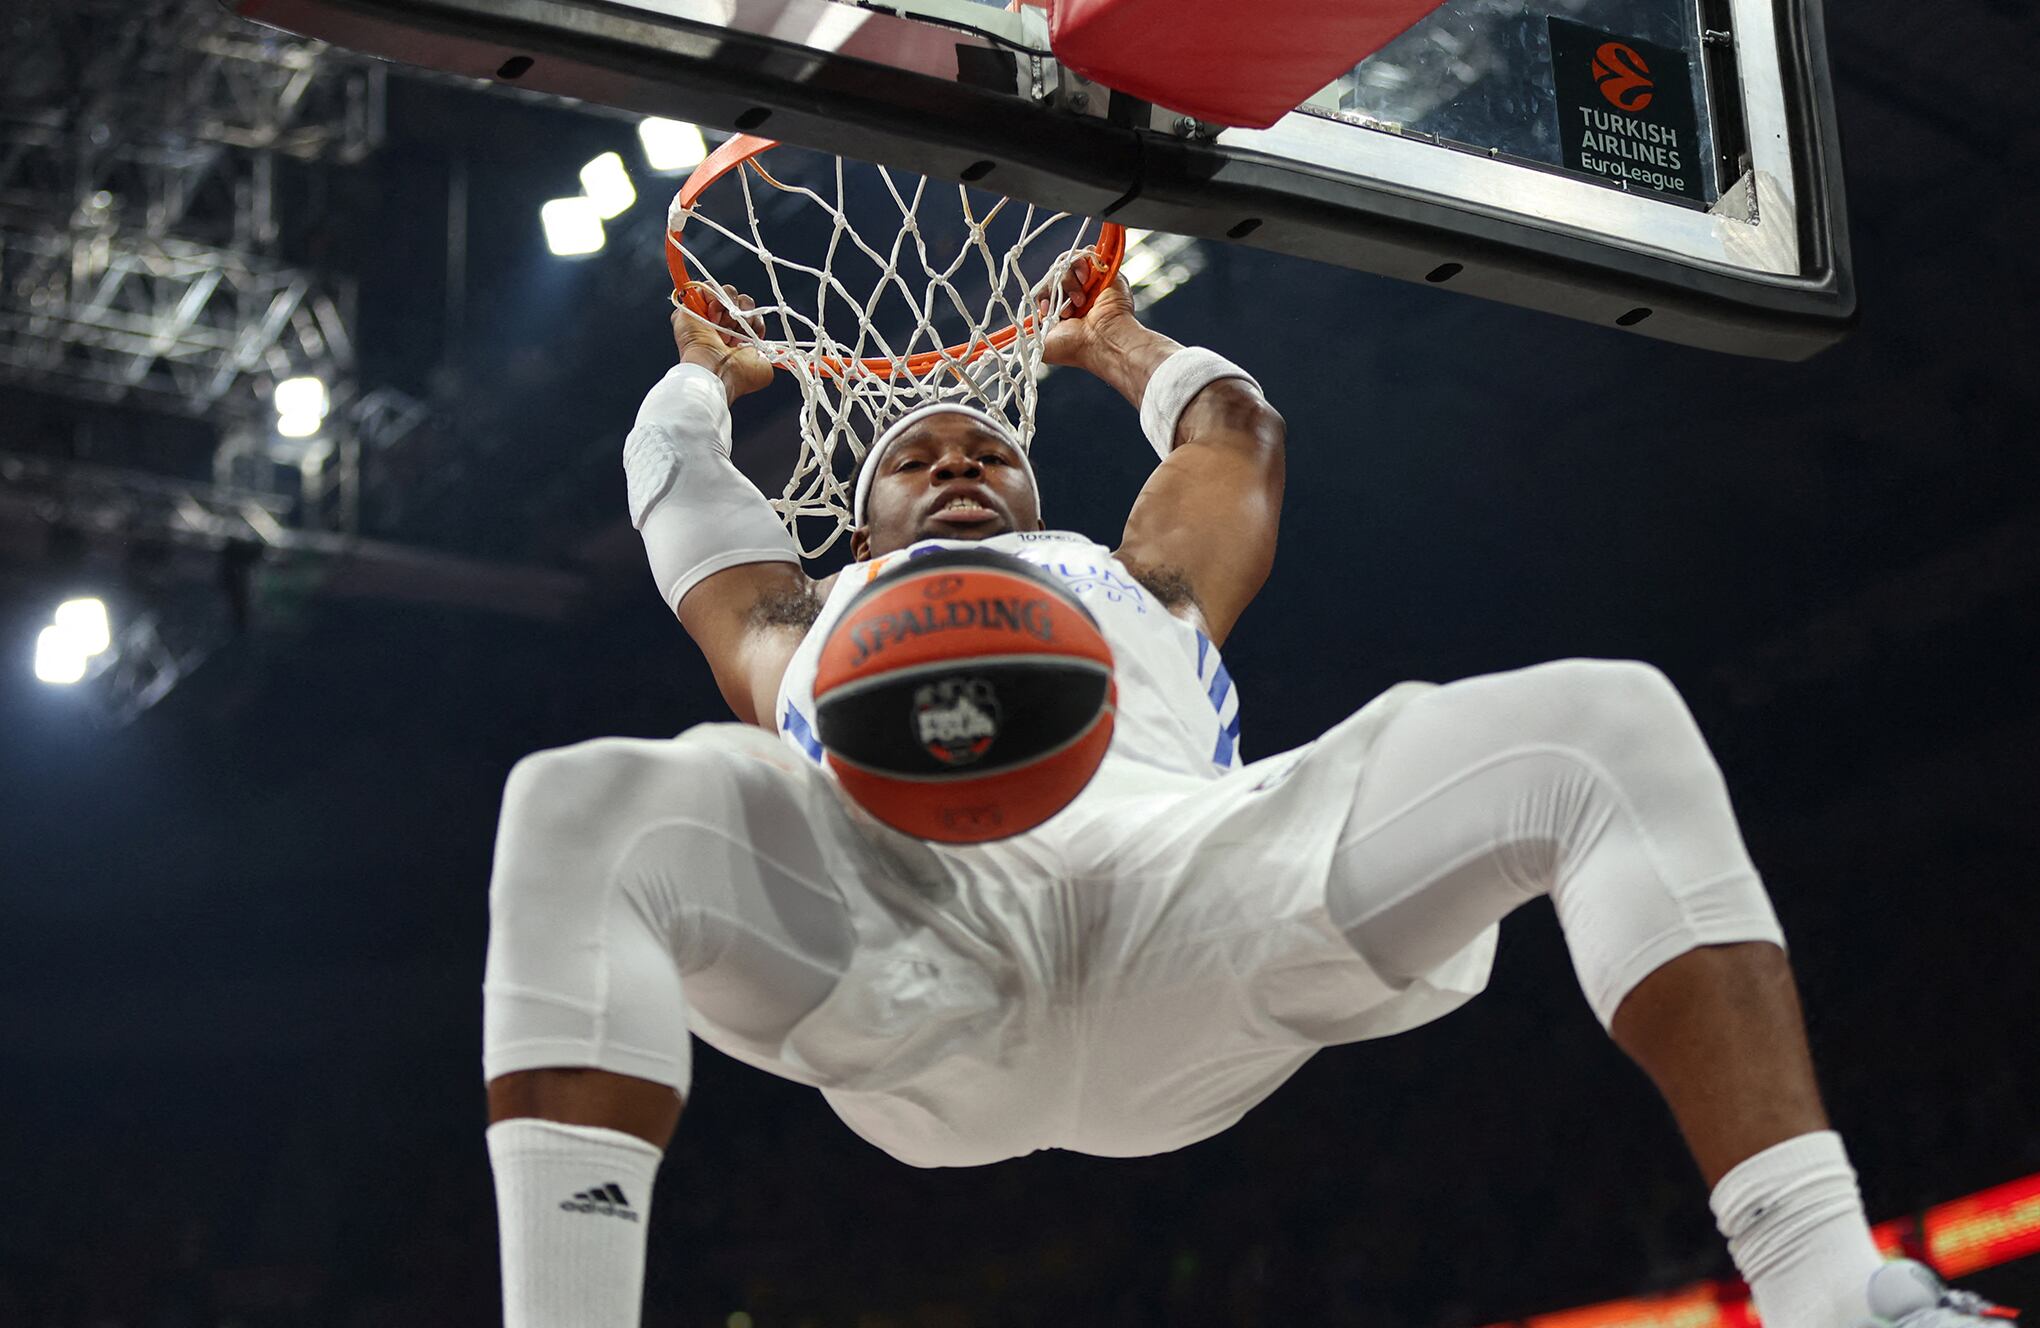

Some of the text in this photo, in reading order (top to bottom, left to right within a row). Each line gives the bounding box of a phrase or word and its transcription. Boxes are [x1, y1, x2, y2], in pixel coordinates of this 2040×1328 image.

[1579, 106, 1677, 147] TURKISH
[1582, 131, 1681, 170] AIRLINES
[1581, 152, 1685, 191] EuroLeague
[851, 598, 1054, 667] SPALDING
